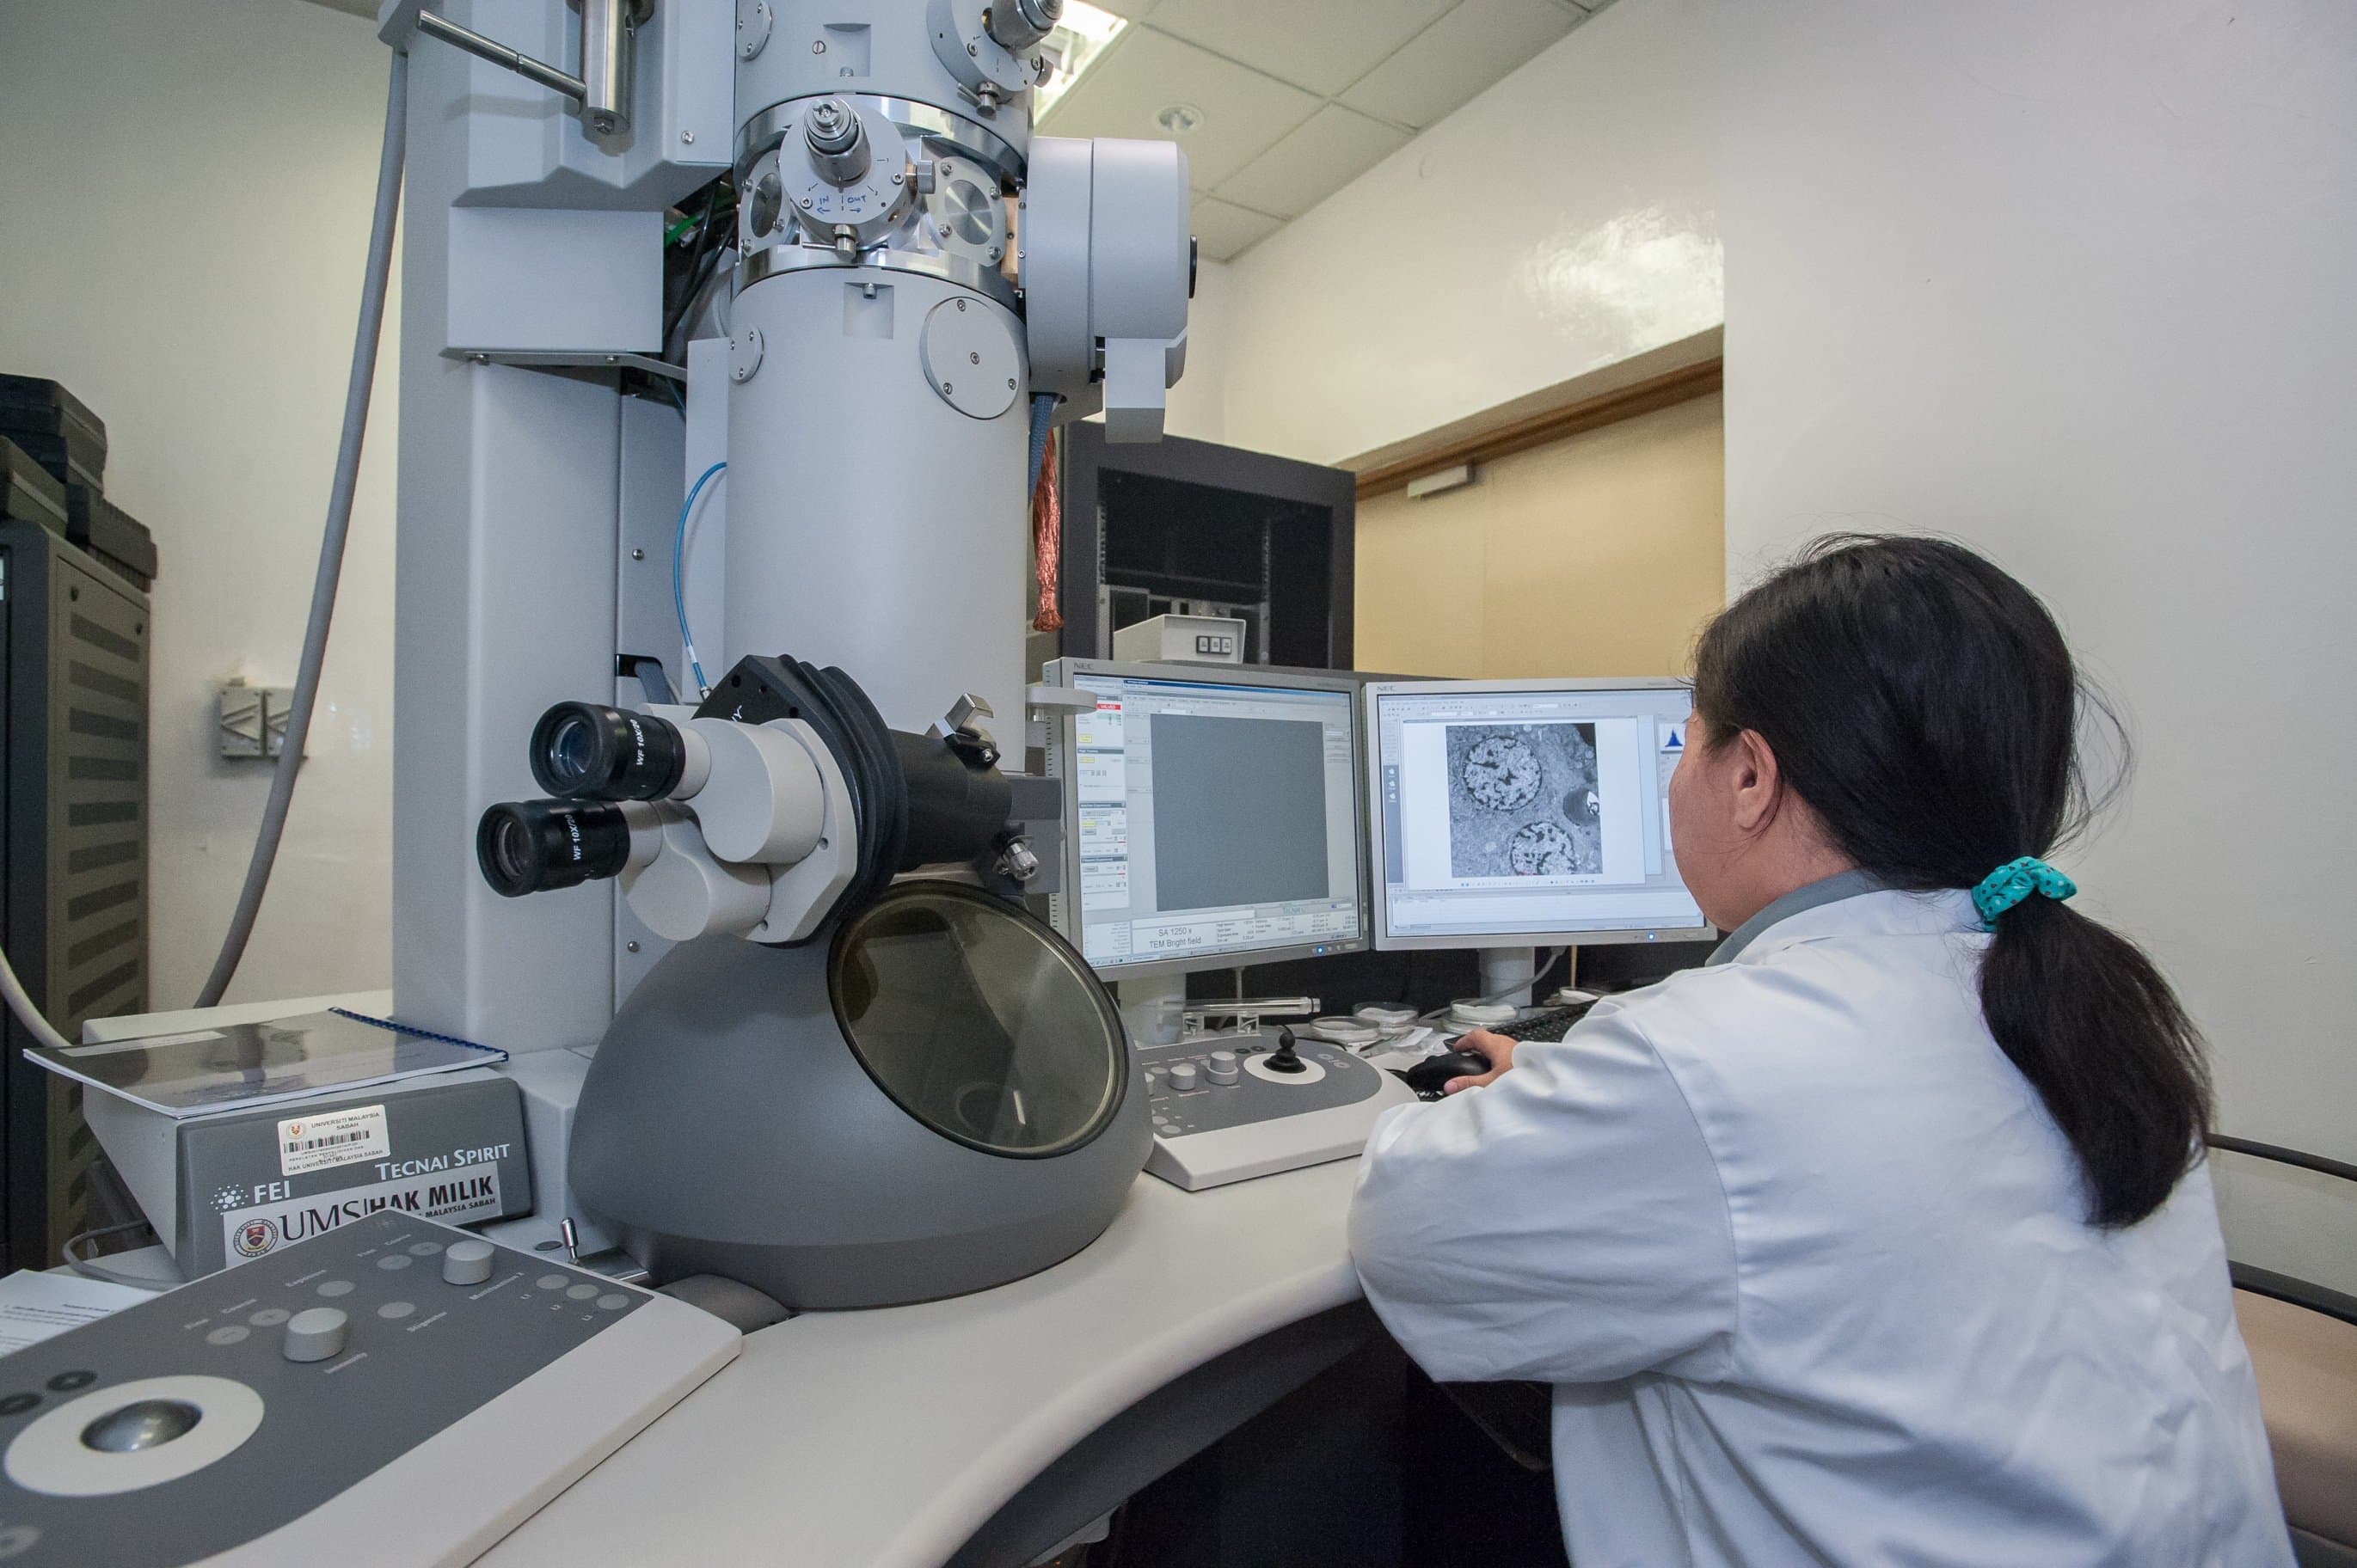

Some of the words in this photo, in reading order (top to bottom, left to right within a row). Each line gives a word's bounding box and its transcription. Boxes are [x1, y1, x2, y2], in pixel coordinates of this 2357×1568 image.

[819, 195, 830, 205] IN
[847, 195, 867, 204] OUT
[1073, 662, 1094, 671] NEC
[635, 749, 645, 766] WF
[564, 814, 581, 843] 10X/20
[573, 845, 581, 861] WF
[1170, 928, 1187, 936] 1250
[1149, 940, 1165, 949] TEM
[1167, 938, 1186, 948] Bright
[1188, 936, 1201, 945] field
[310, 1118, 347, 1129] UNIVERSITI
[348, 1112, 380, 1122] MALAYSIA
[336, 1122, 359, 1130] SABAH
[375, 1155, 448, 1180] TECNAI
[454, 1143, 510, 1167] SPIRIT
[254, 1180, 292, 1204] FEI
[429, 1175, 494, 1208] MILIK
[425, 1204, 467, 1218] MALAYSIA
[469, 1197, 496, 1209] SABAH
